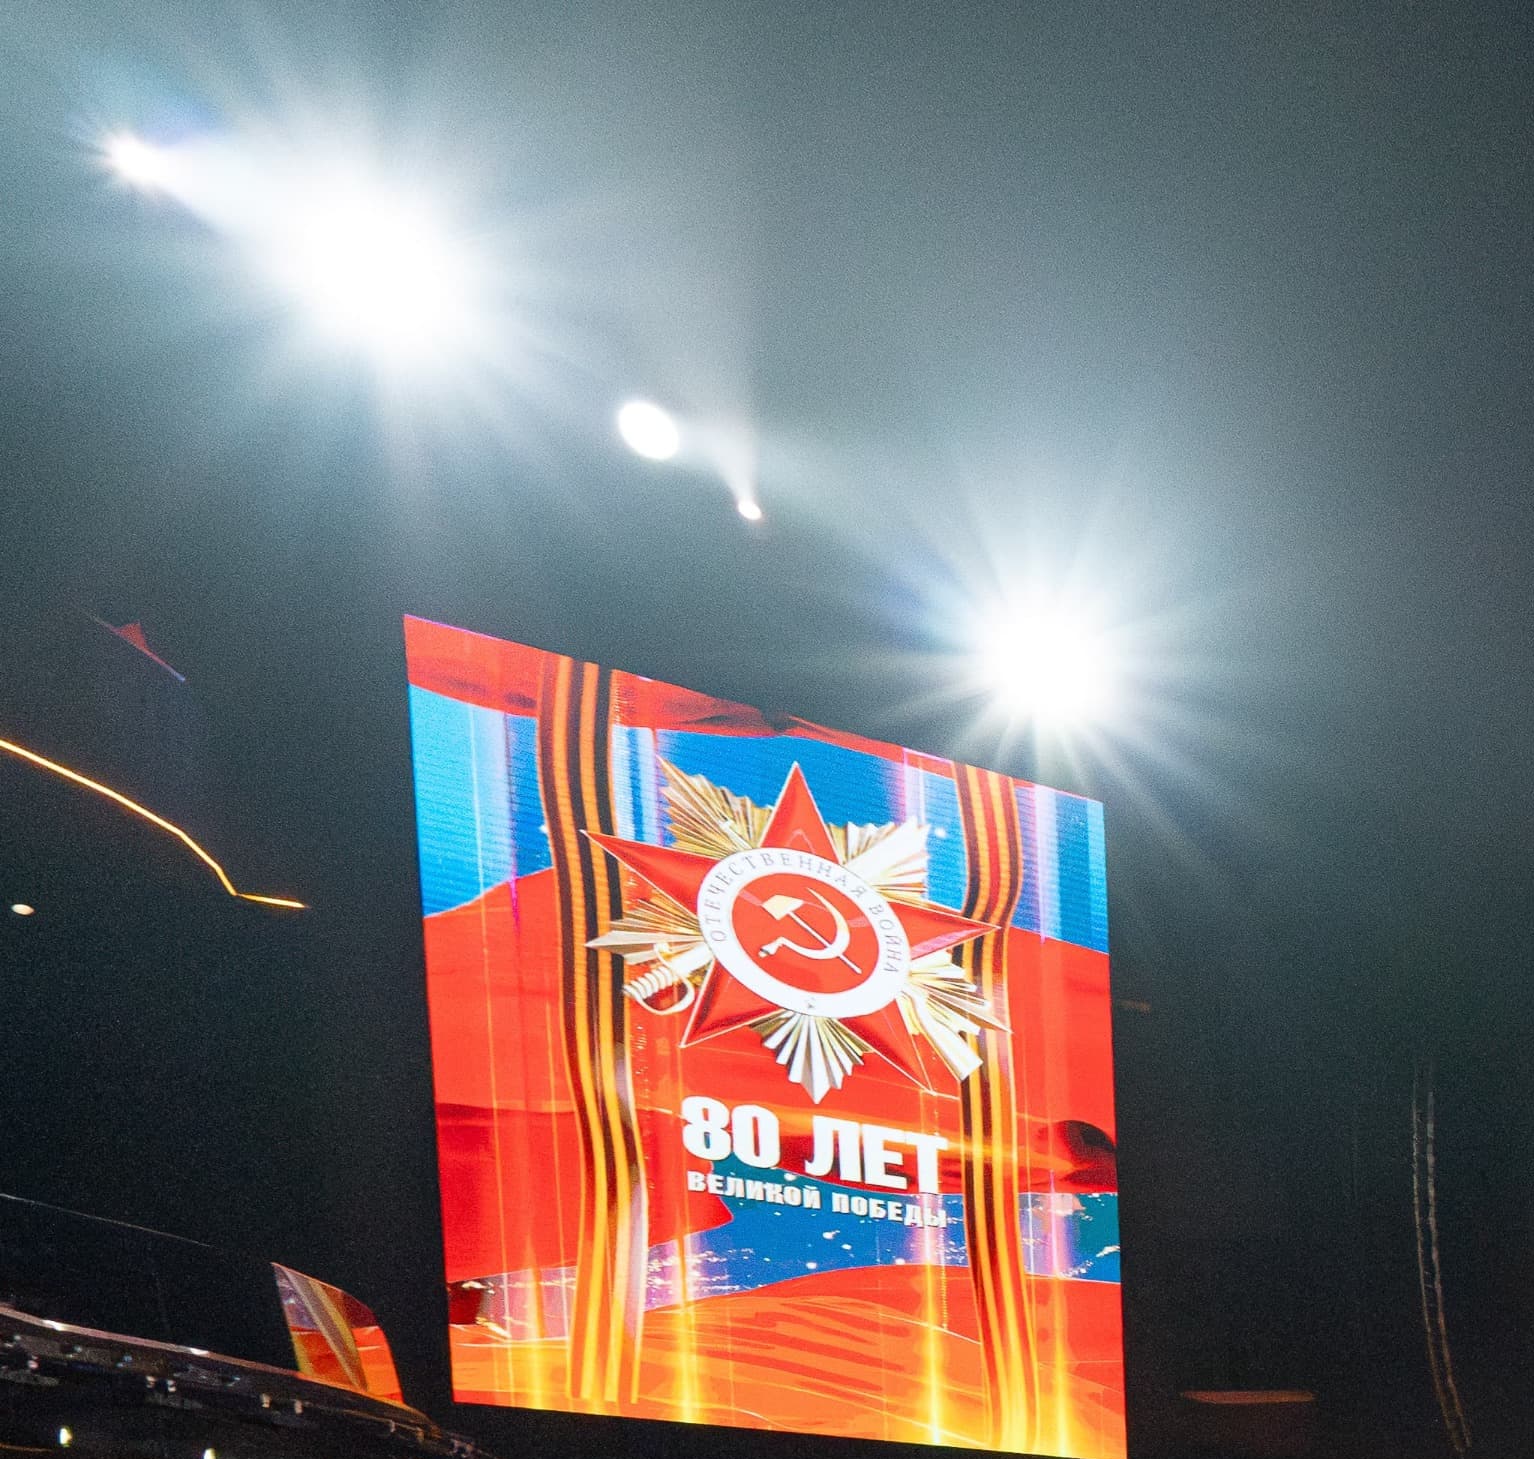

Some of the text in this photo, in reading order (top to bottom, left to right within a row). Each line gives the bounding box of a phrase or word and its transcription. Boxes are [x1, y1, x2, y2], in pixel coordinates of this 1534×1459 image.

[704, 852, 867, 942] ОТЕЧЕСТВЕННАЯ
[681, 1095, 949, 1195] 80 ЛЕТ
[686, 1170, 948, 1229] ВЕЛИКОЙ ПОБЕДЫ
